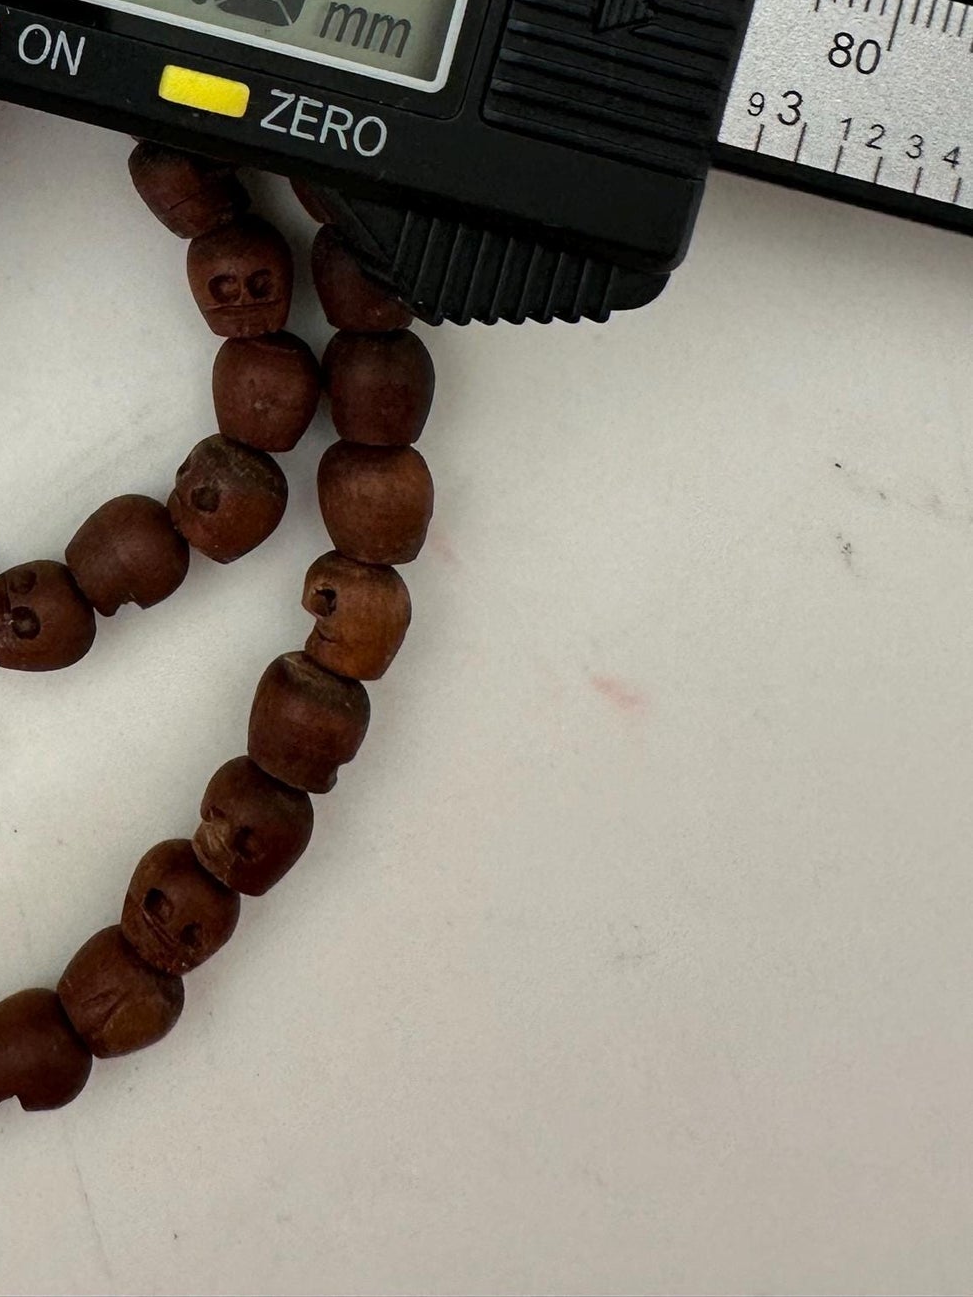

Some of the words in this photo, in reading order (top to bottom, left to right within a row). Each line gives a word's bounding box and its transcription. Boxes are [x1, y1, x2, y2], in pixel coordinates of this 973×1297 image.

[17, 23, 87, 77] ON
[319, 0, 413, 59] mm
[827, 31, 882, 75] 80
[259, 87, 389, 158] ZERO
[746, 91, 765, 117] 9
[776, 89, 804, 126] 3
[839, 117, 853, 141] 1
[864, 123, 886, 150] 2
[905, 133, 924, 159] 3
[942, 145, 961, 169] 4
